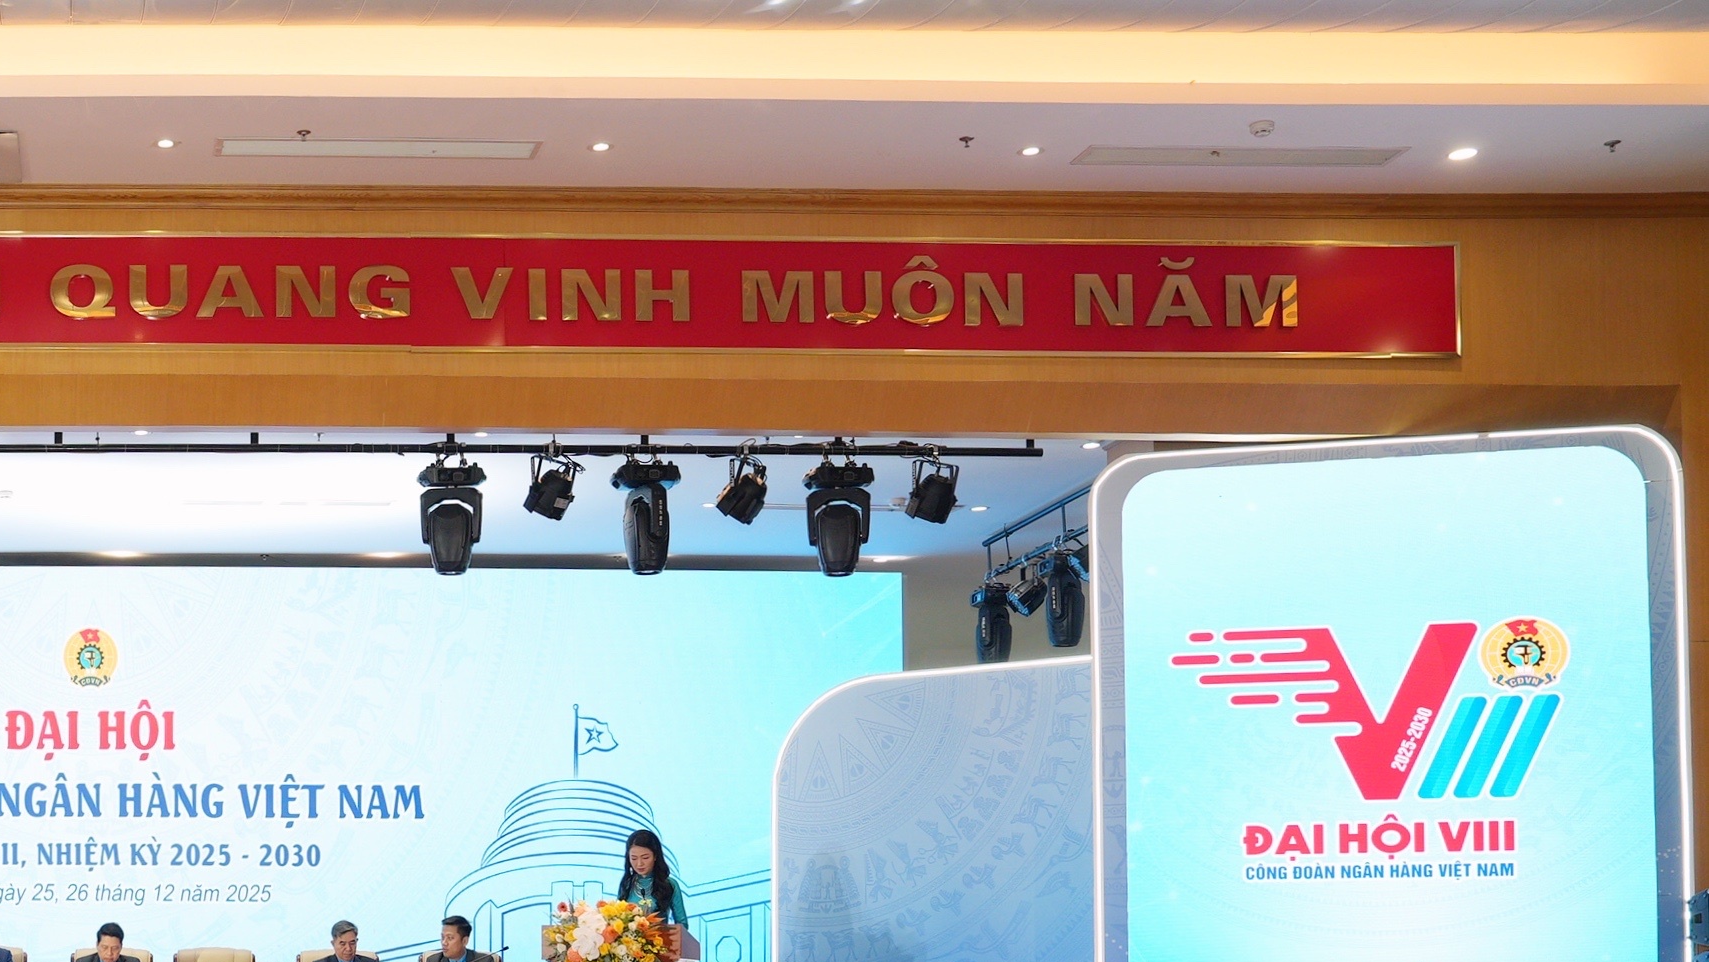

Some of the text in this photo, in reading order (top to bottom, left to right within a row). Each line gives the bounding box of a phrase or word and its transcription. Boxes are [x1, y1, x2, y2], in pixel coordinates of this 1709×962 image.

[49, 263, 411, 321] QUANG
[450, 267, 690, 321] VINH
[741, 255, 1024, 327] MUÔN
[1075, 257, 1299, 328] NĂM
[4, 698, 176, 761] ĐẠI HỘI
[1390, 706, 1433, 773] 2025-2030
[117, 771, 225, 819] HÀNG
[237, 773, 326, 829] VIỆT
[337, 784, 425, 820] NAM
[36, 836, 121, 872] NHIỆM
[129, 835, 162, 866] KỲ
[170, 843, 231, 867] 2025
[259, 843, 321, 868] 2030
[1242, 813, 1516, 862] ĐẠI HỘI VIII
[31, 882, 59, 904] 25,
[65, 883, 89, 902] 26
[95, 883, 146, 907] tháng
[154, 883, 175, 902] 12
[180, 884, 220, 903] năm
[225, 883, 272, 903] 2025
[1245, 860, 1515, 881] CÔNG ĐOÀN NGÂN HÀNG VIỆT NAM
